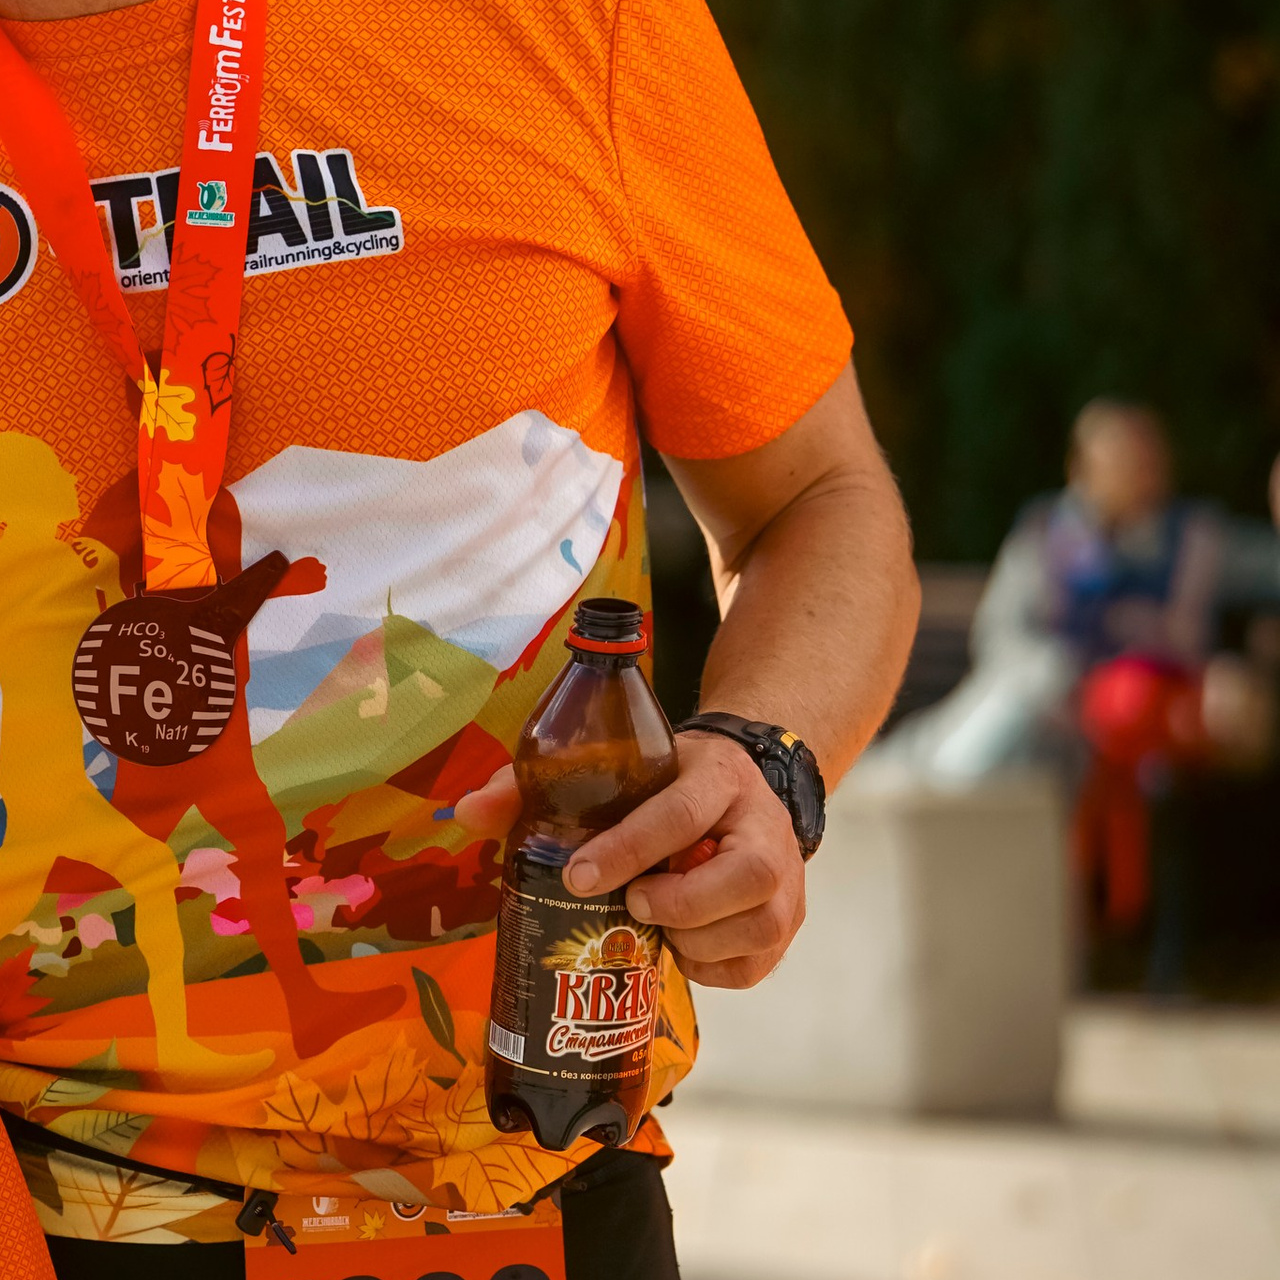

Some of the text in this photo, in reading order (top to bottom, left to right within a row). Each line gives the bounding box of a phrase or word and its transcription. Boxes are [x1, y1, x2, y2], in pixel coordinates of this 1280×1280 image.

[110, 660, 206, 720] Fe 26
[155, 723, 189, 740] Na11
[543, 898, 627, 914] продукт натураль
[553, 969, 657, 1021] КВАС
[561, 1068, 640, 1081] без консервантов
